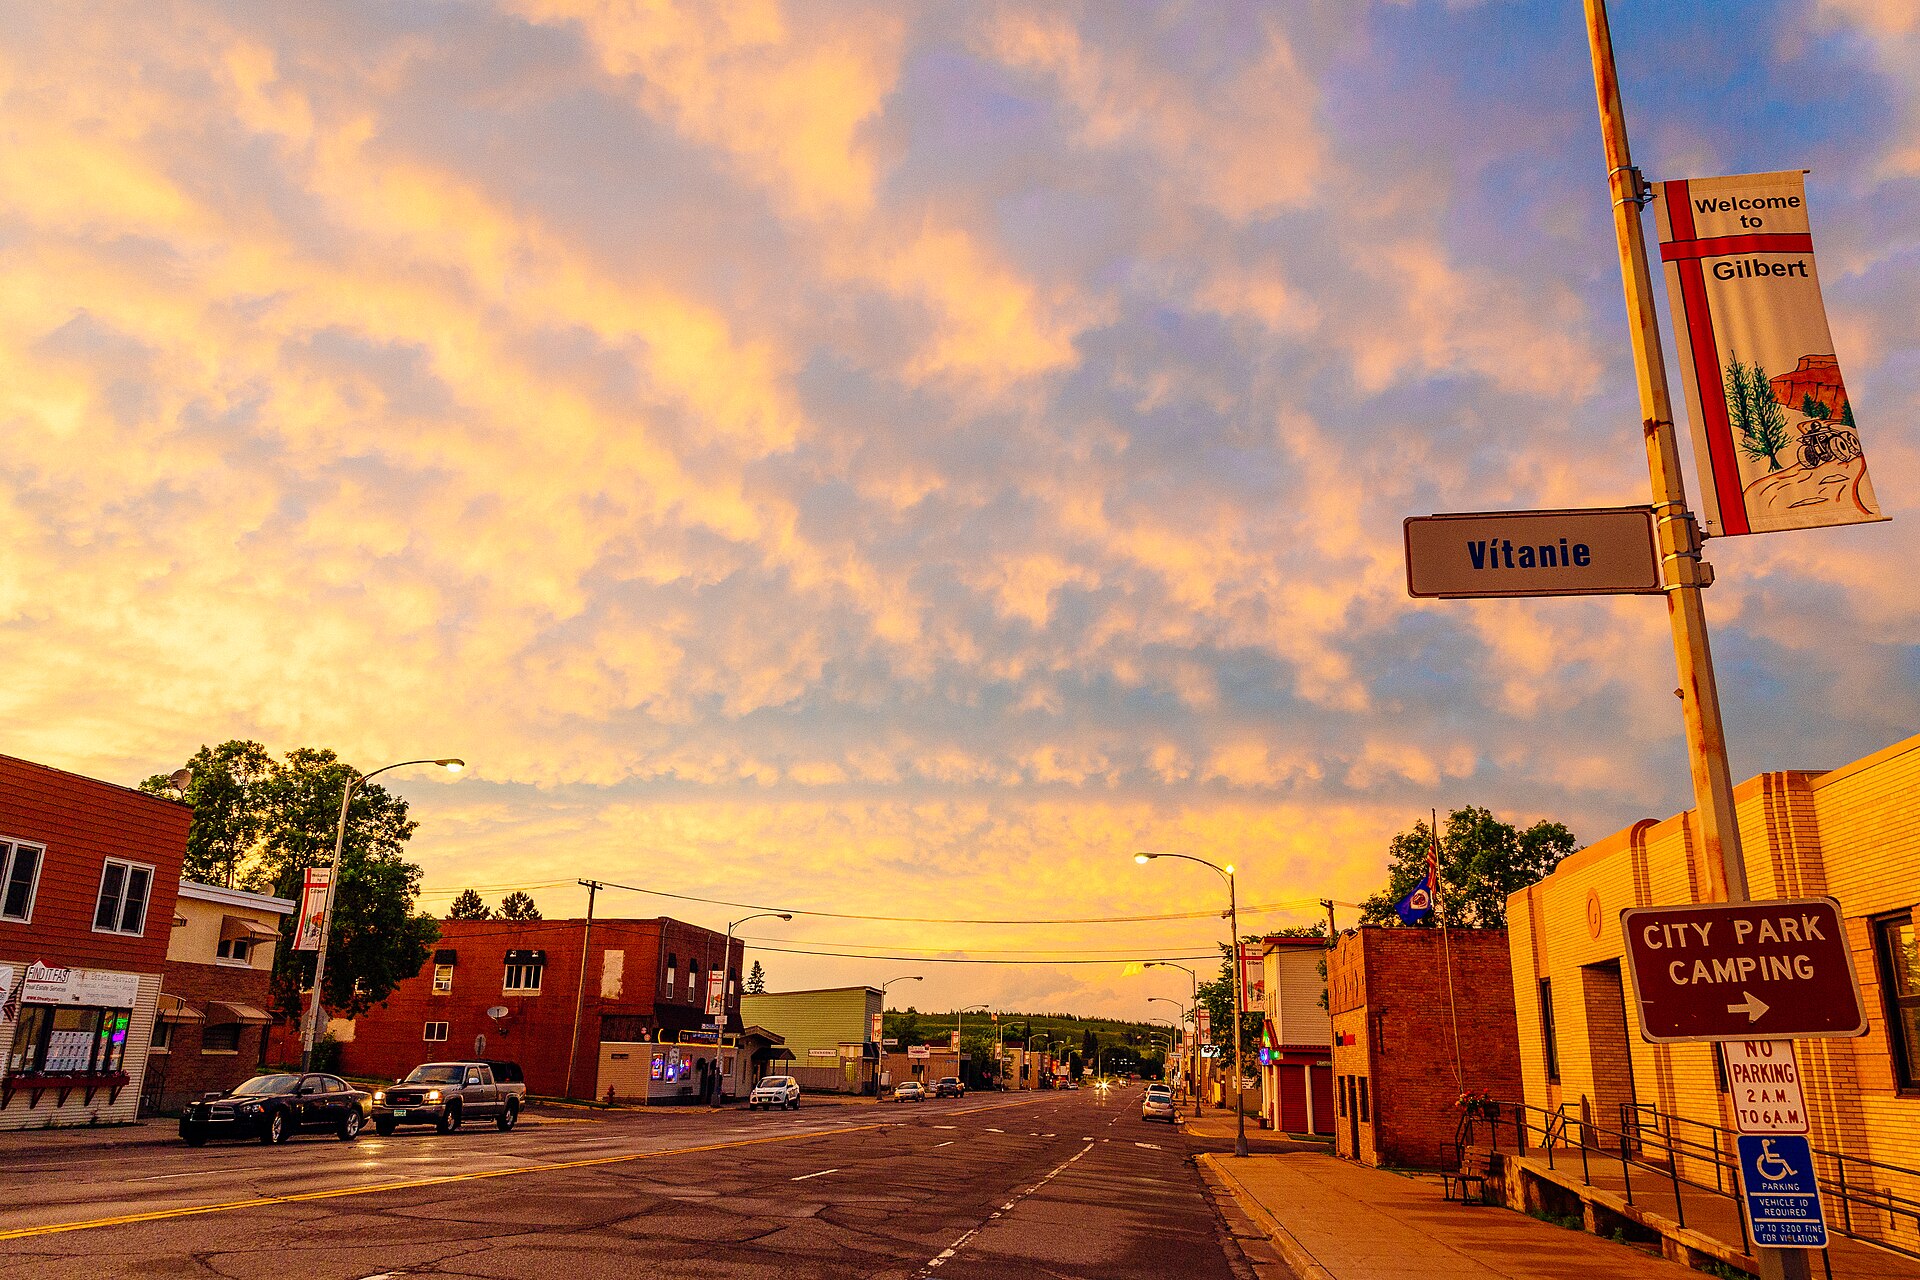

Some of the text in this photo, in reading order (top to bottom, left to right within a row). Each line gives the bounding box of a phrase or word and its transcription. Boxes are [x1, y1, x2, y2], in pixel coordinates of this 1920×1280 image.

[1695, 195, 1801, 214] Welcome
[1740, 214, 1764, 229] to
[1713, 258, 1809, 281] Gilbert
[1467, 538, 1591, 570] Vítanie
[1643, 915, 1826, 950] CITY PARK
[28, 966, 45, 980] FIND
[53, 968, 71, 983] FAST
[1669, 955, 1815, 985] CAMPING
[1744, 1041, 1773, 1058] NO
[1733, 1063, 1795, 1084] PARKING
[1746, 1089, 1791, 1103] 2 A.M.
[1740, 1110, 1759, 1124] TO
[1761, 1182, 1800, 1191] PARKING
[1759, 1198, 1809, 1207] VEHICLE ID
[1764, 1208, 1807, 1217] REQUIRED
[1754, 1224, 1823, 1233] UP TO $200 FINE
[1762, 1234, 1777, 1243] FOR
